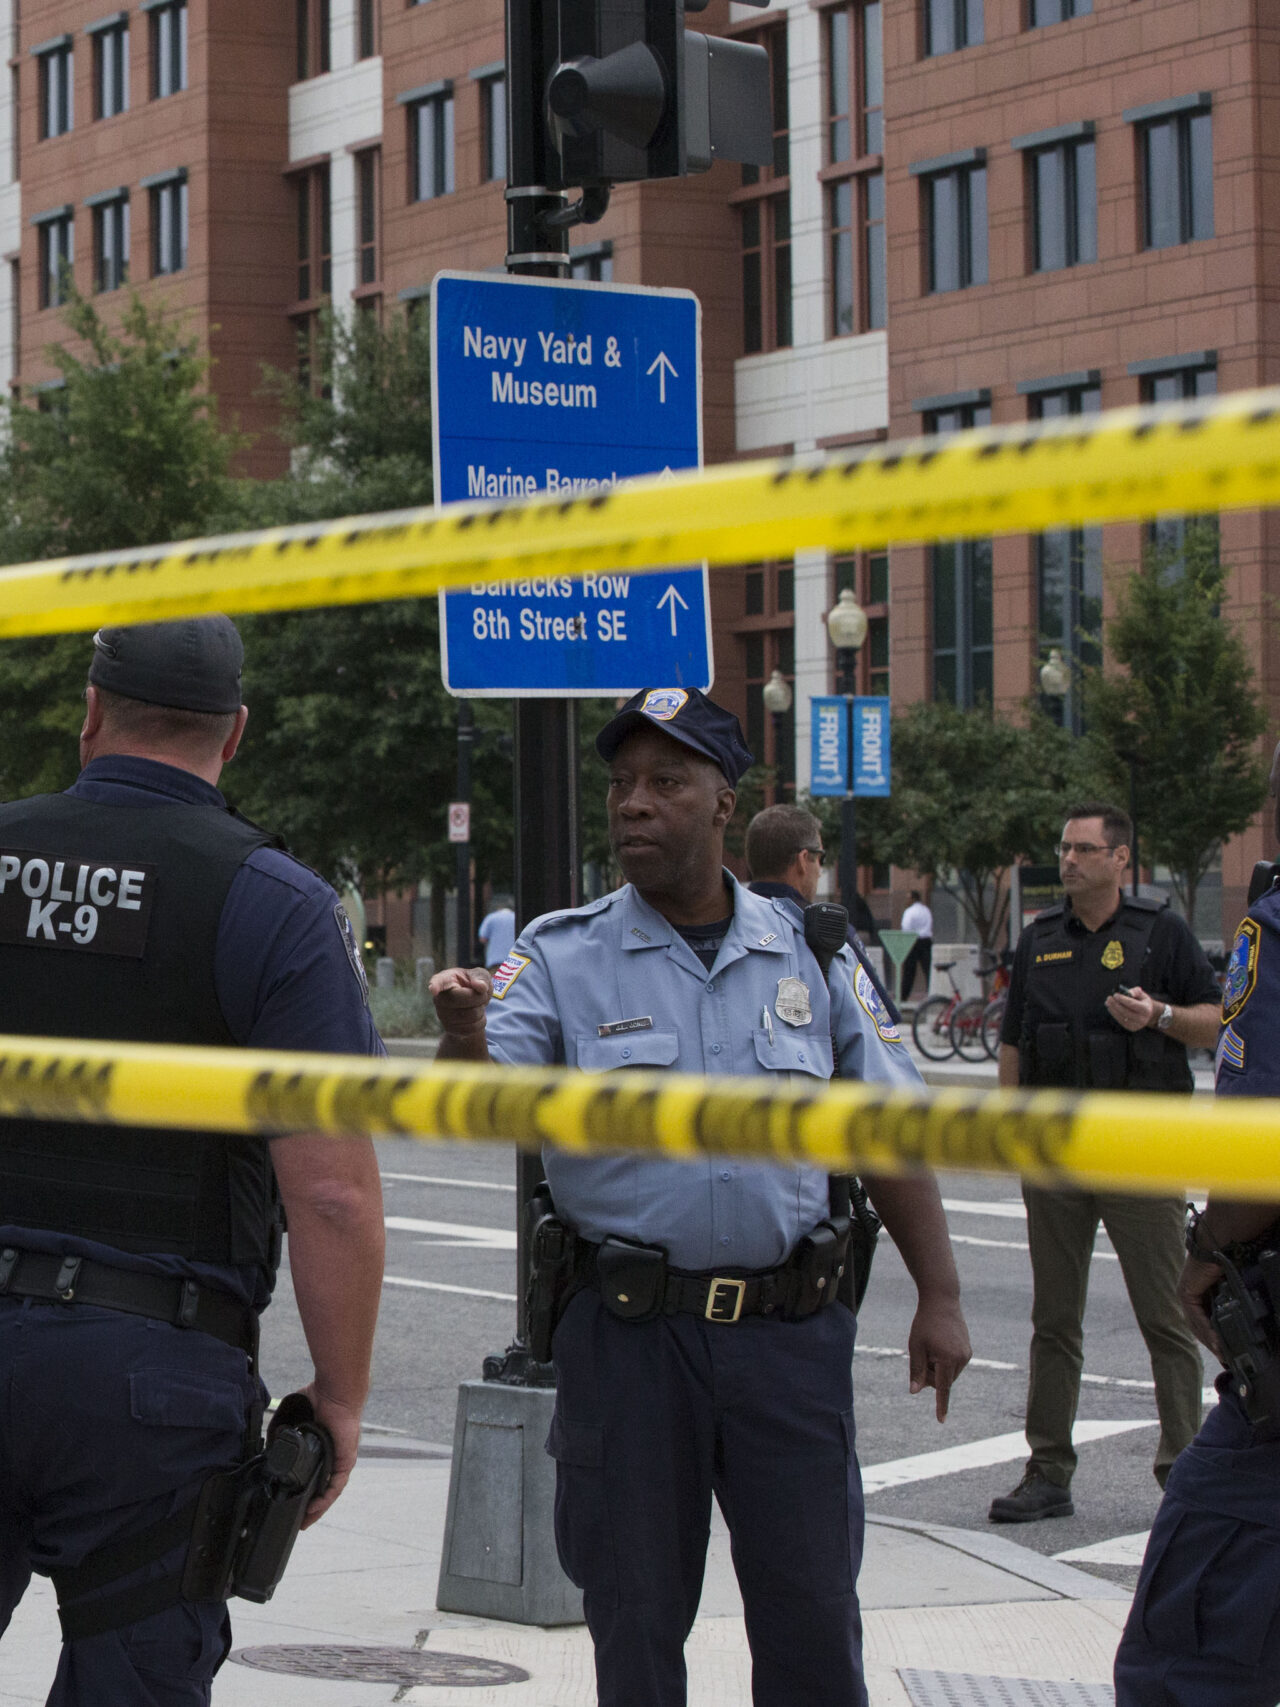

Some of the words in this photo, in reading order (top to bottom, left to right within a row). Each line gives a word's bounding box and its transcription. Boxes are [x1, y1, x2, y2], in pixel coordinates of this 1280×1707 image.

[462, 325, 527, 367] Navy
[537, 331, 593, 366] Yard
[604, 336, 622, 368] &
[491, 371, 597, 408] Museum
[467, 465, 538, 498] Marine
[582, 570, 631, 600] Row
[472, 607, 511, 641] 8th
[520, 608, 588, 642] Street
[597, 609, 627, 642] SE
[819, 712, 839, 773] FRONT
[862, 713, 882, 775] FRONT
[26, 899, 99, 944] K-9
